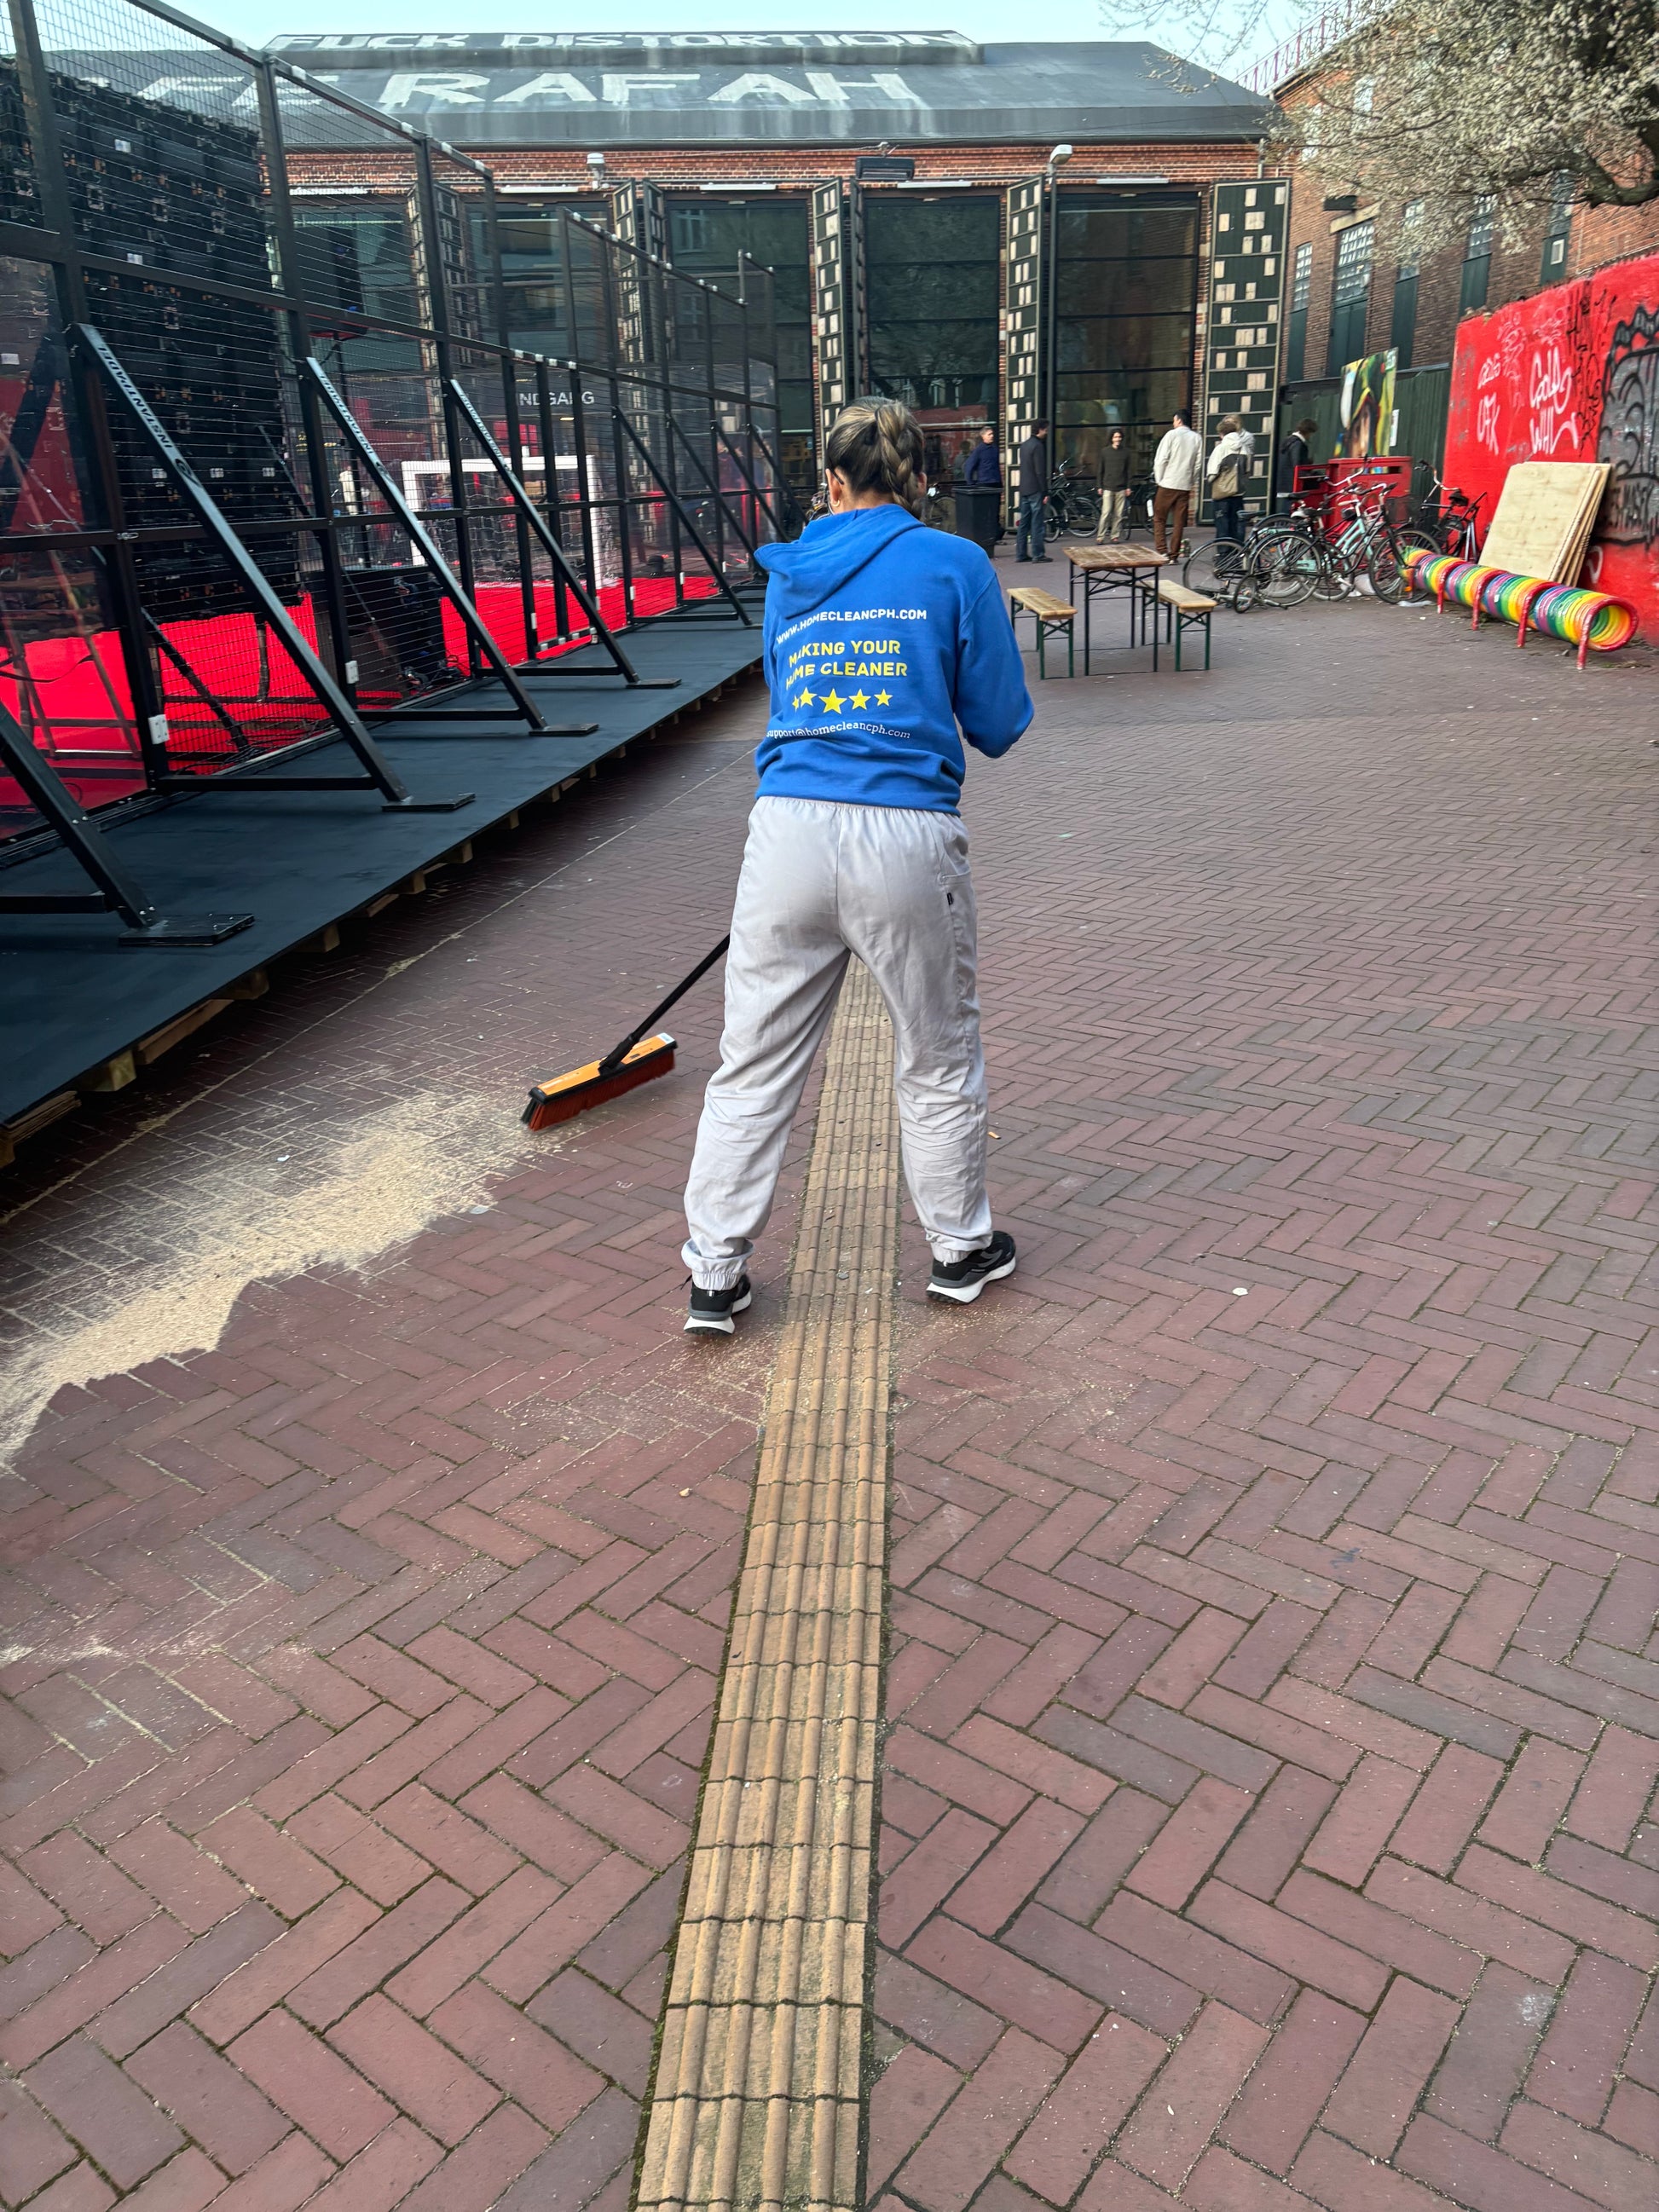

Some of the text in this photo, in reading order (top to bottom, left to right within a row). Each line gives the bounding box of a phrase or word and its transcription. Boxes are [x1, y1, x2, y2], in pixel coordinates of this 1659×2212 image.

[267, 32, 975, 49] FUCK DISTORTION
[379, 72, 925, 104] RAFAH
[518, 391, 595, 406] NDGAG
[777, 609, 927, 645] WWW.HOMECLEANCPH.COM
[851, 640, 901, 655] YOUR
[820, 661, 908, 677] CLEANER
